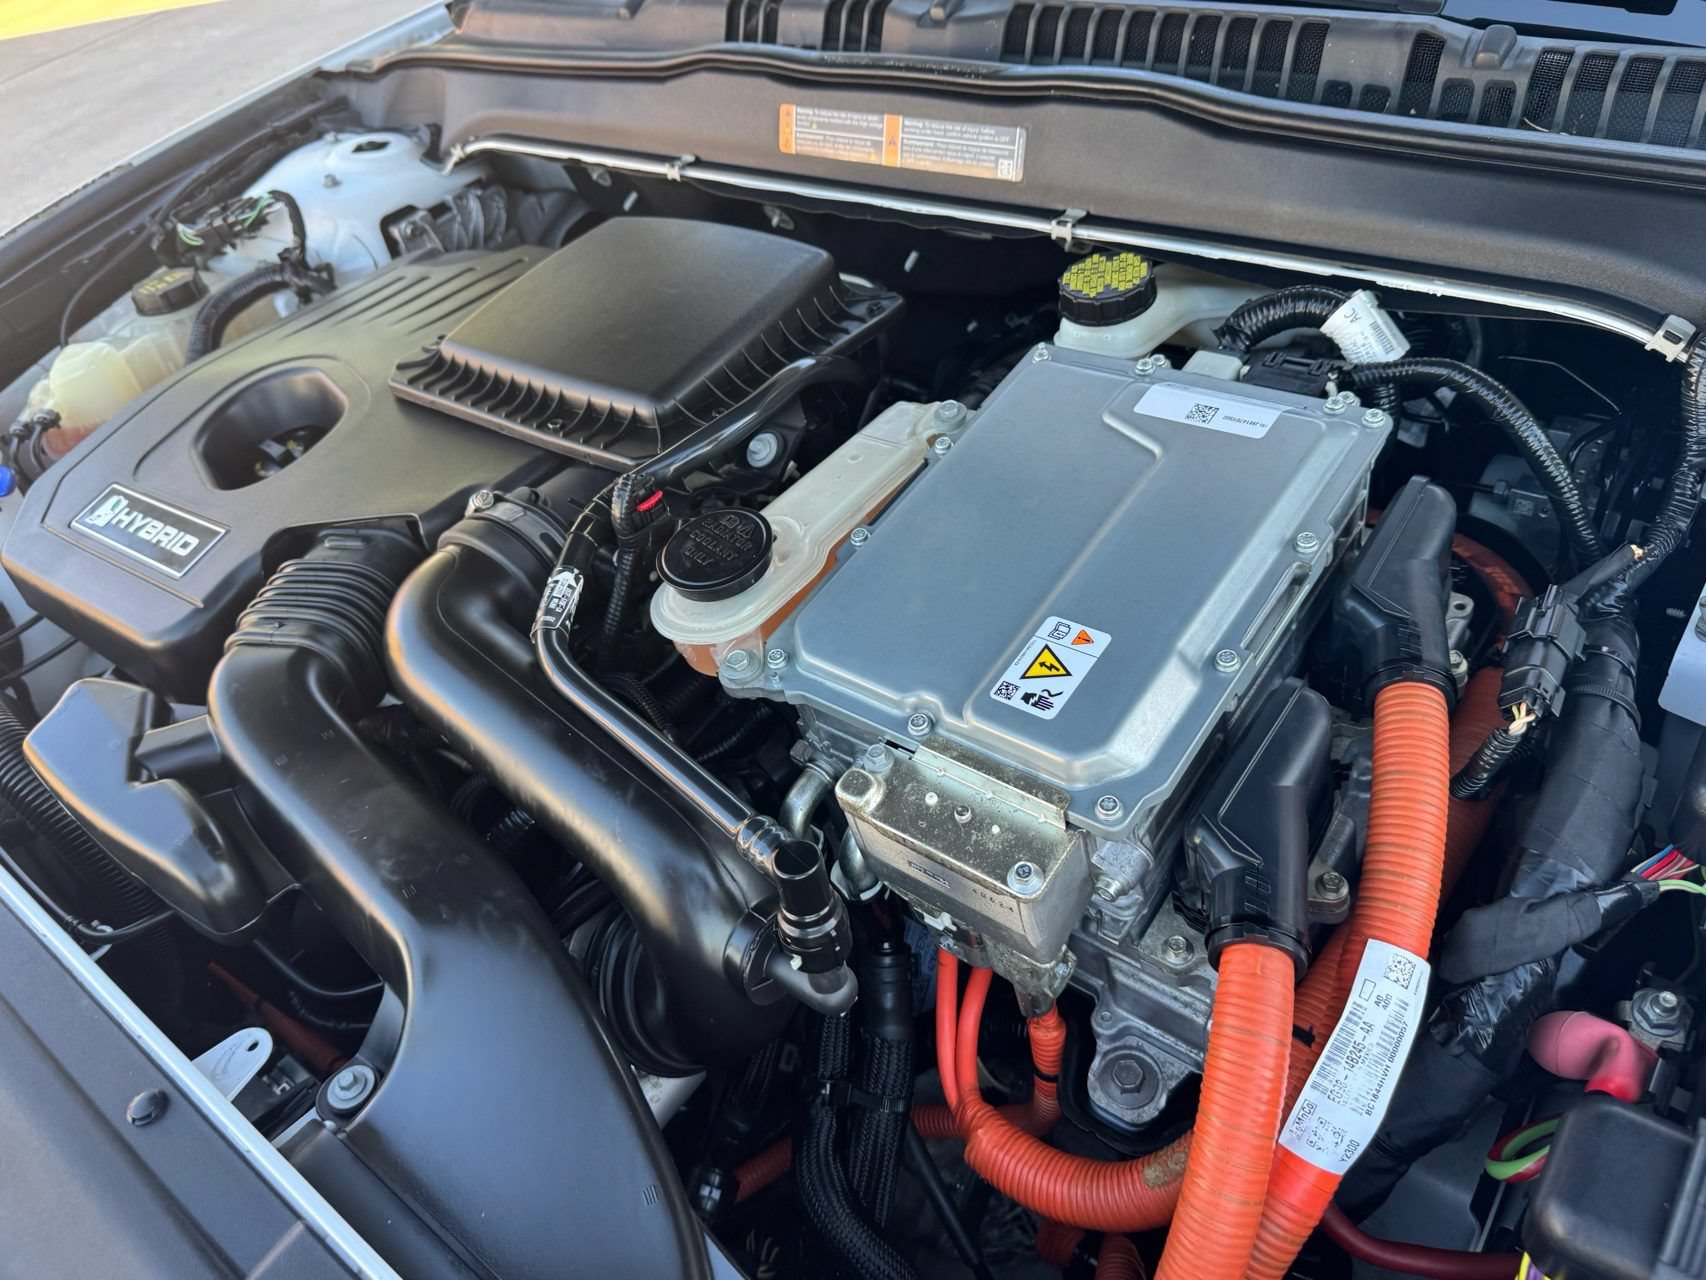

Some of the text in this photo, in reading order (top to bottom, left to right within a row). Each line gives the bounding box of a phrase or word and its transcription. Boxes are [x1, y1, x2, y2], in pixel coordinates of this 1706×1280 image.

[112, 507, 200, 557] HYBRID
[689, 529, 738, 561] COOLANT
[702, 518, 753, 552] RADIATOR
[684, 542, 715, 566] ONLY
[1341, 1139, 1361, 1162] Y2300
